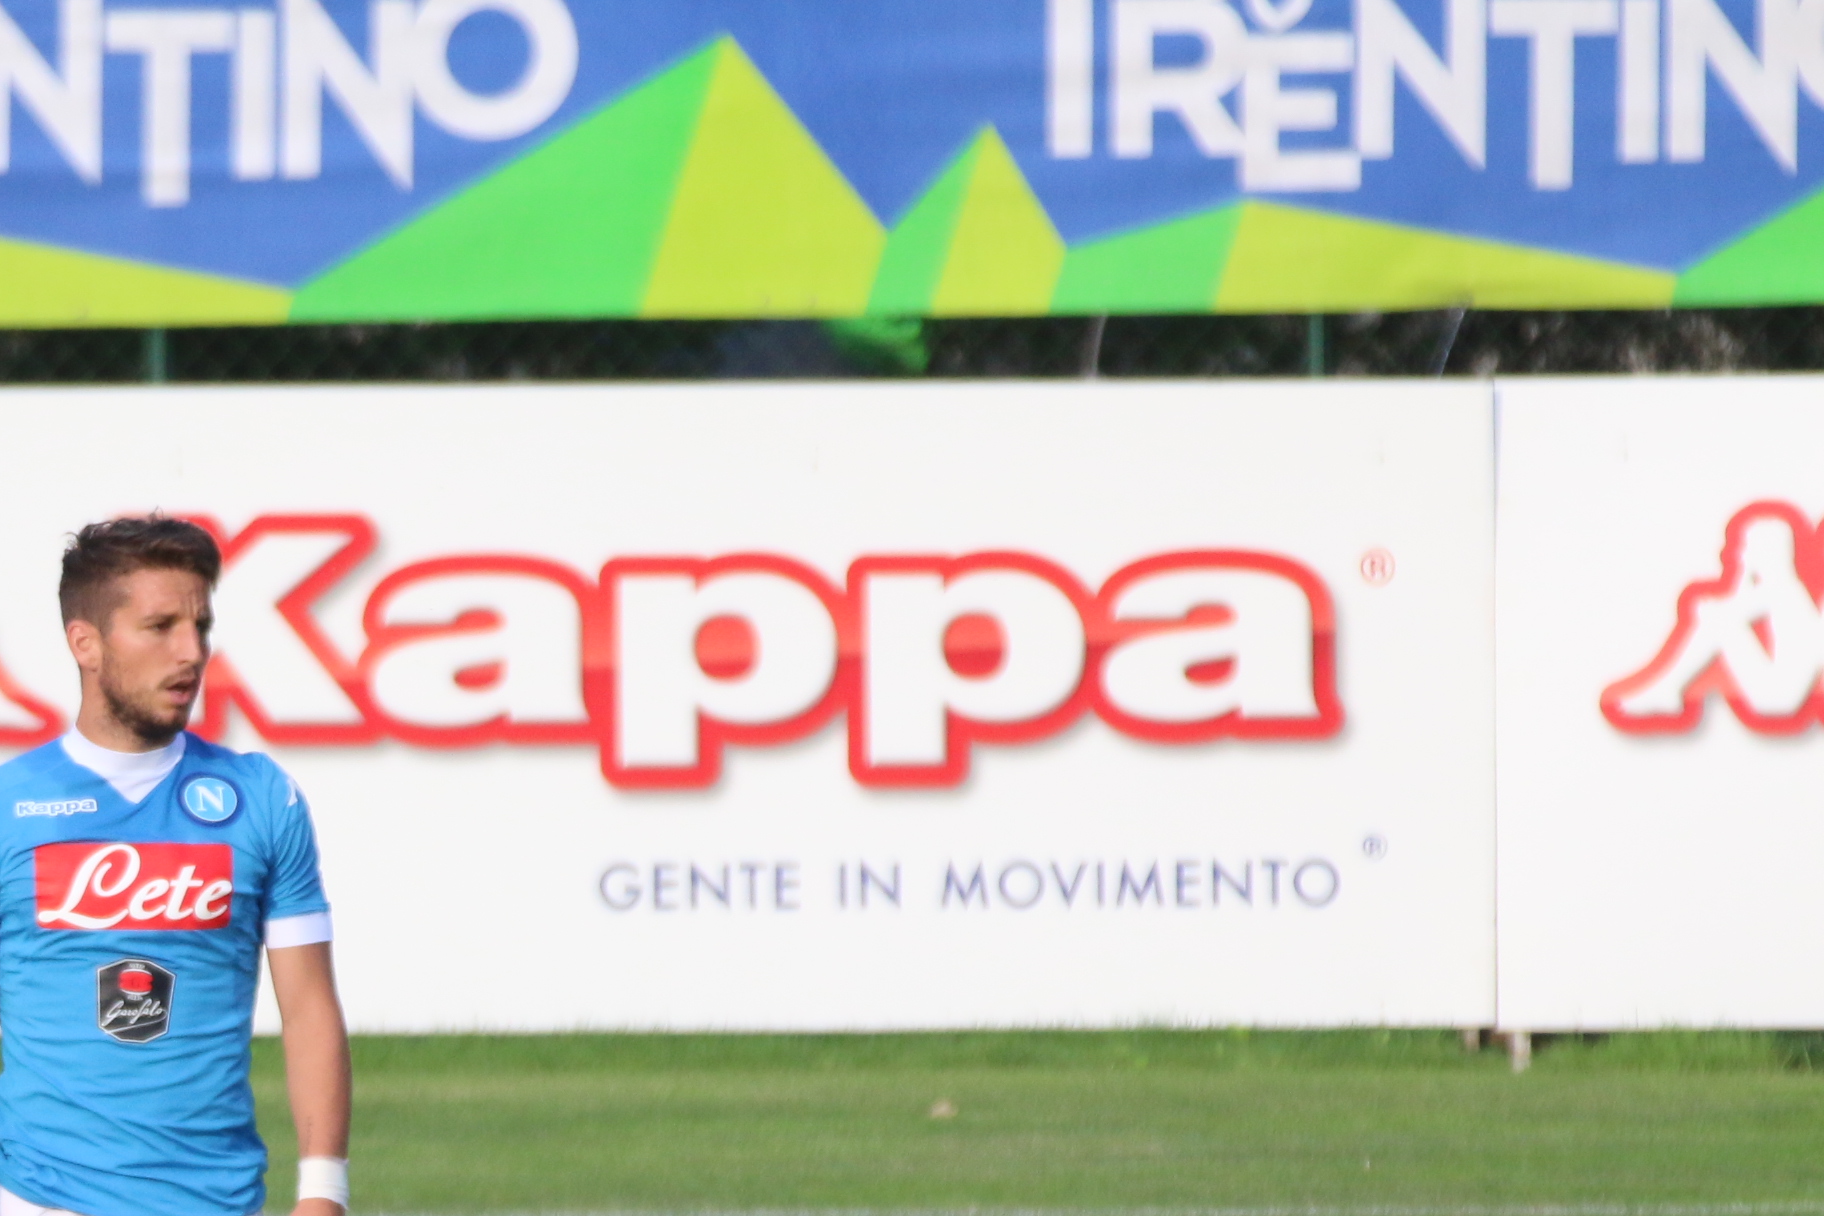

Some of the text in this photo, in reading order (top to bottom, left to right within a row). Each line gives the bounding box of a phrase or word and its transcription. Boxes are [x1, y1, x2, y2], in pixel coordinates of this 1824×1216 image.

[1046, 0, 1824, 193] TRENTIN
[16, 799, 98, 816] Kappa
[195, 786, 225, 812] N
[38, 843, 233, 929] Lete
[596, 861, 800, 912] GENTE
[836, 860, 902, 910] IN
[939, 856, 1341, 911] MOVIMENTO
